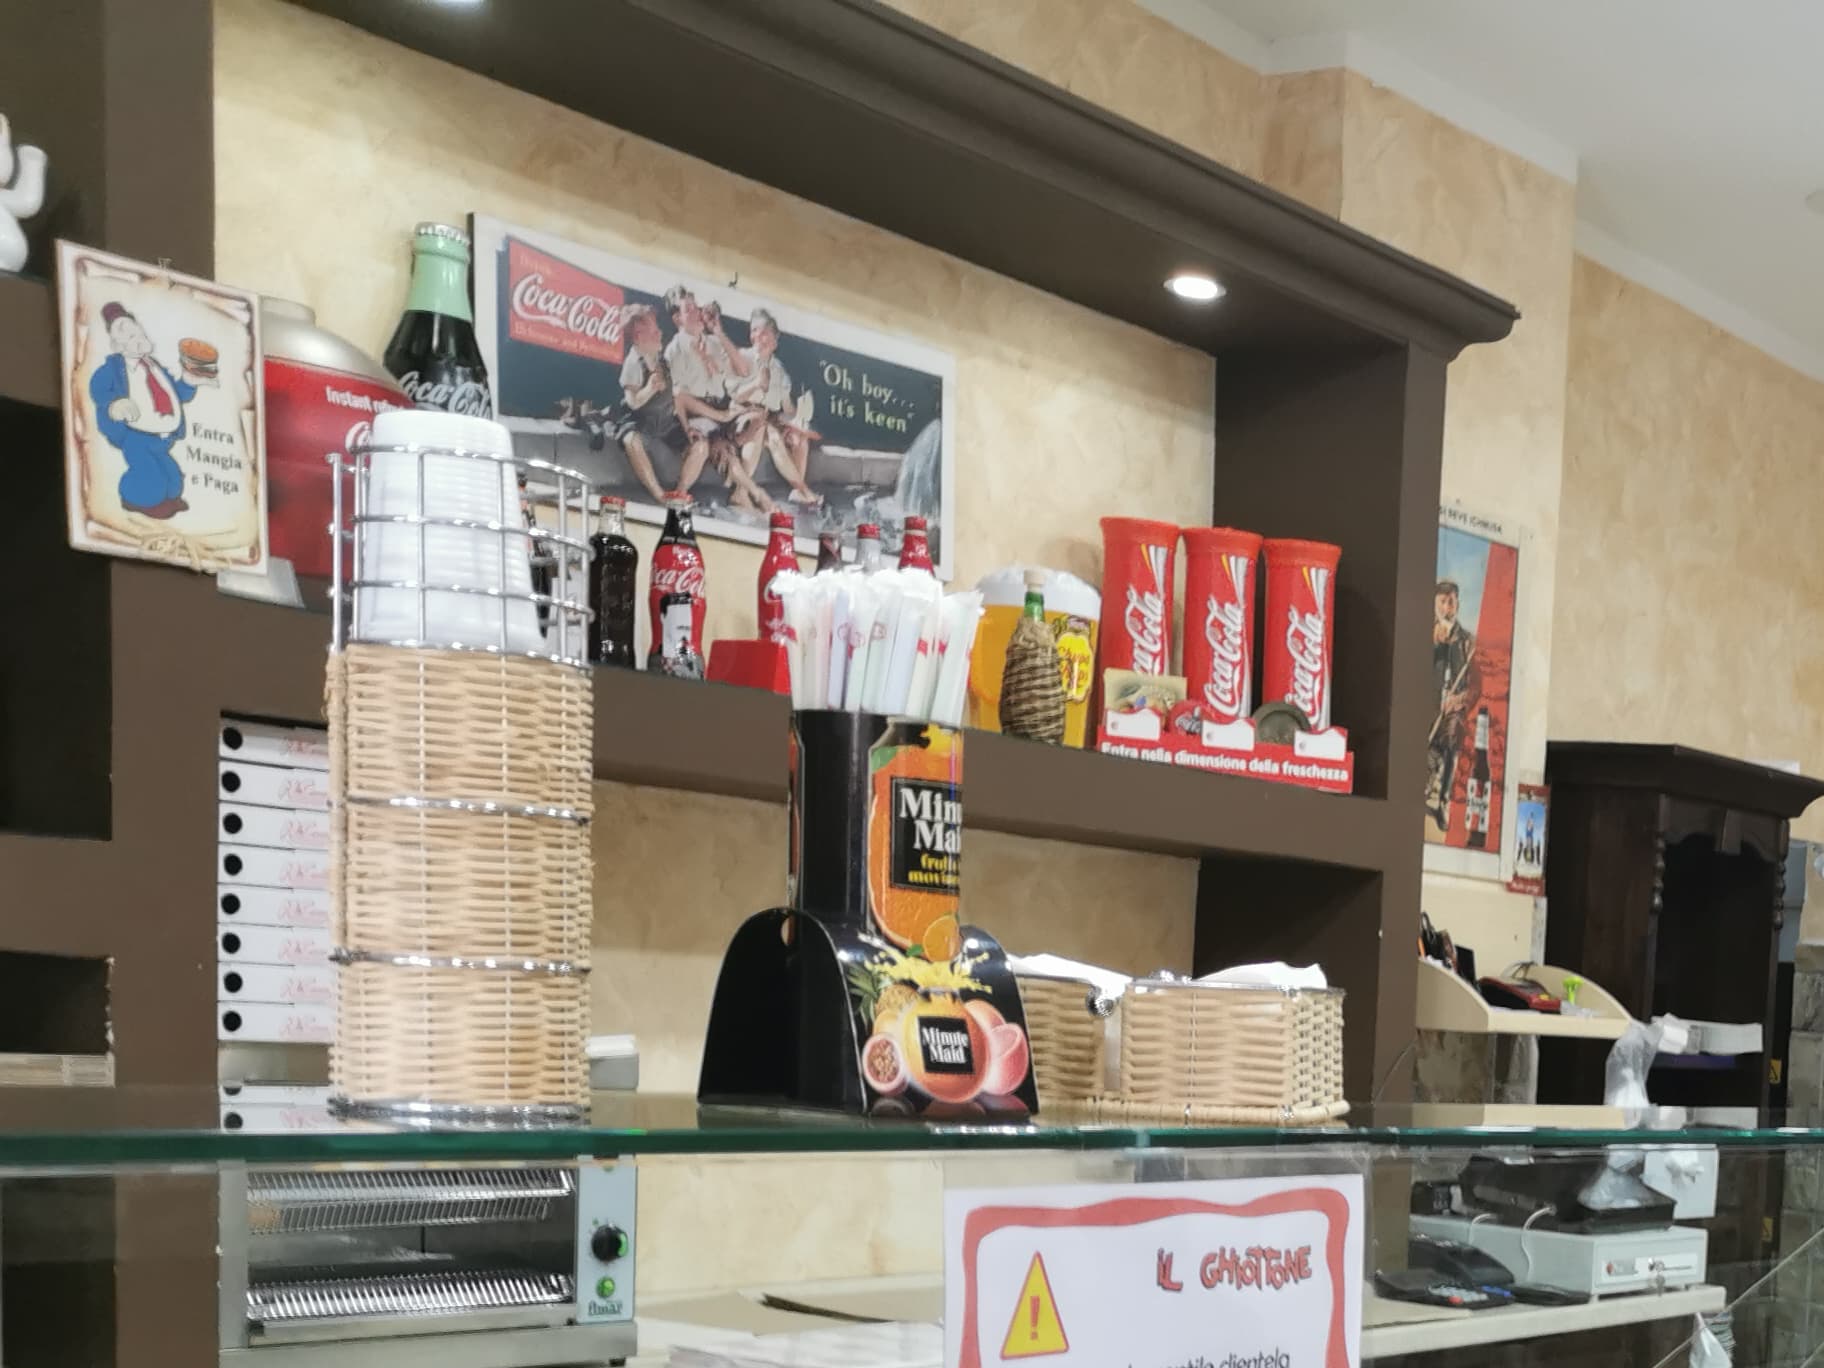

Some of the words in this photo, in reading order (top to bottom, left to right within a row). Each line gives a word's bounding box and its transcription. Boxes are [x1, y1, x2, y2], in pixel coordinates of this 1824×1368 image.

[192, 422, 234, 444] Entra
[186, 445, 242, 470] Mangia
[191, 474, 199, 485] e
[204, 473, 239, 495] Paga
[1204, 594, 1244, 718] Coca-Cola
[1175, 750, 1247, 771] dimensione
[1249, 757, 1280, 774] della
[1282, 760, 1349, 782] freschezza
[899, 787, 962, 824] Min
[913, 820, 961, 853] Mai
[922, 1026, 969, 1048] Minute
[929, 1044, 966, 1063] Maid
[1157, 1247, 1183, 1291] IL
